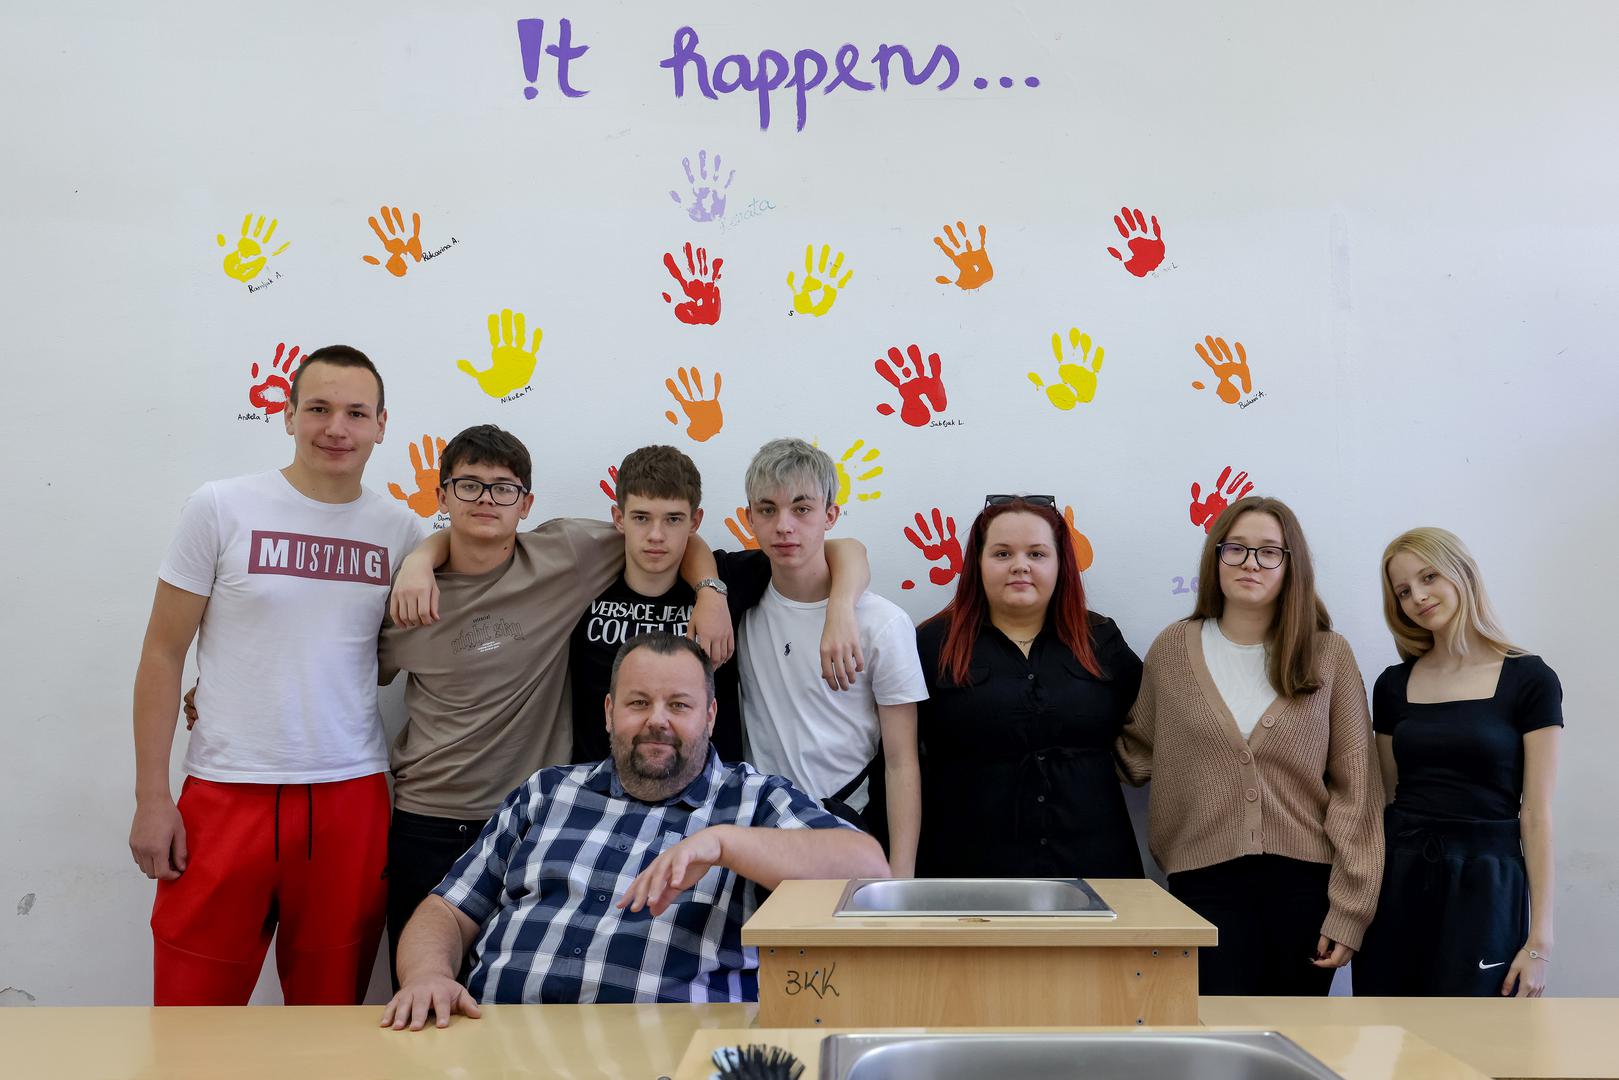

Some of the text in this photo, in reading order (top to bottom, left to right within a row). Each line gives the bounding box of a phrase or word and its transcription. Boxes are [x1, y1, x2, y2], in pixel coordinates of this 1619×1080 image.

[258, 537, 384, 579] MUSTANG
[591, 599, 694, 622] VERSACE JEAN
